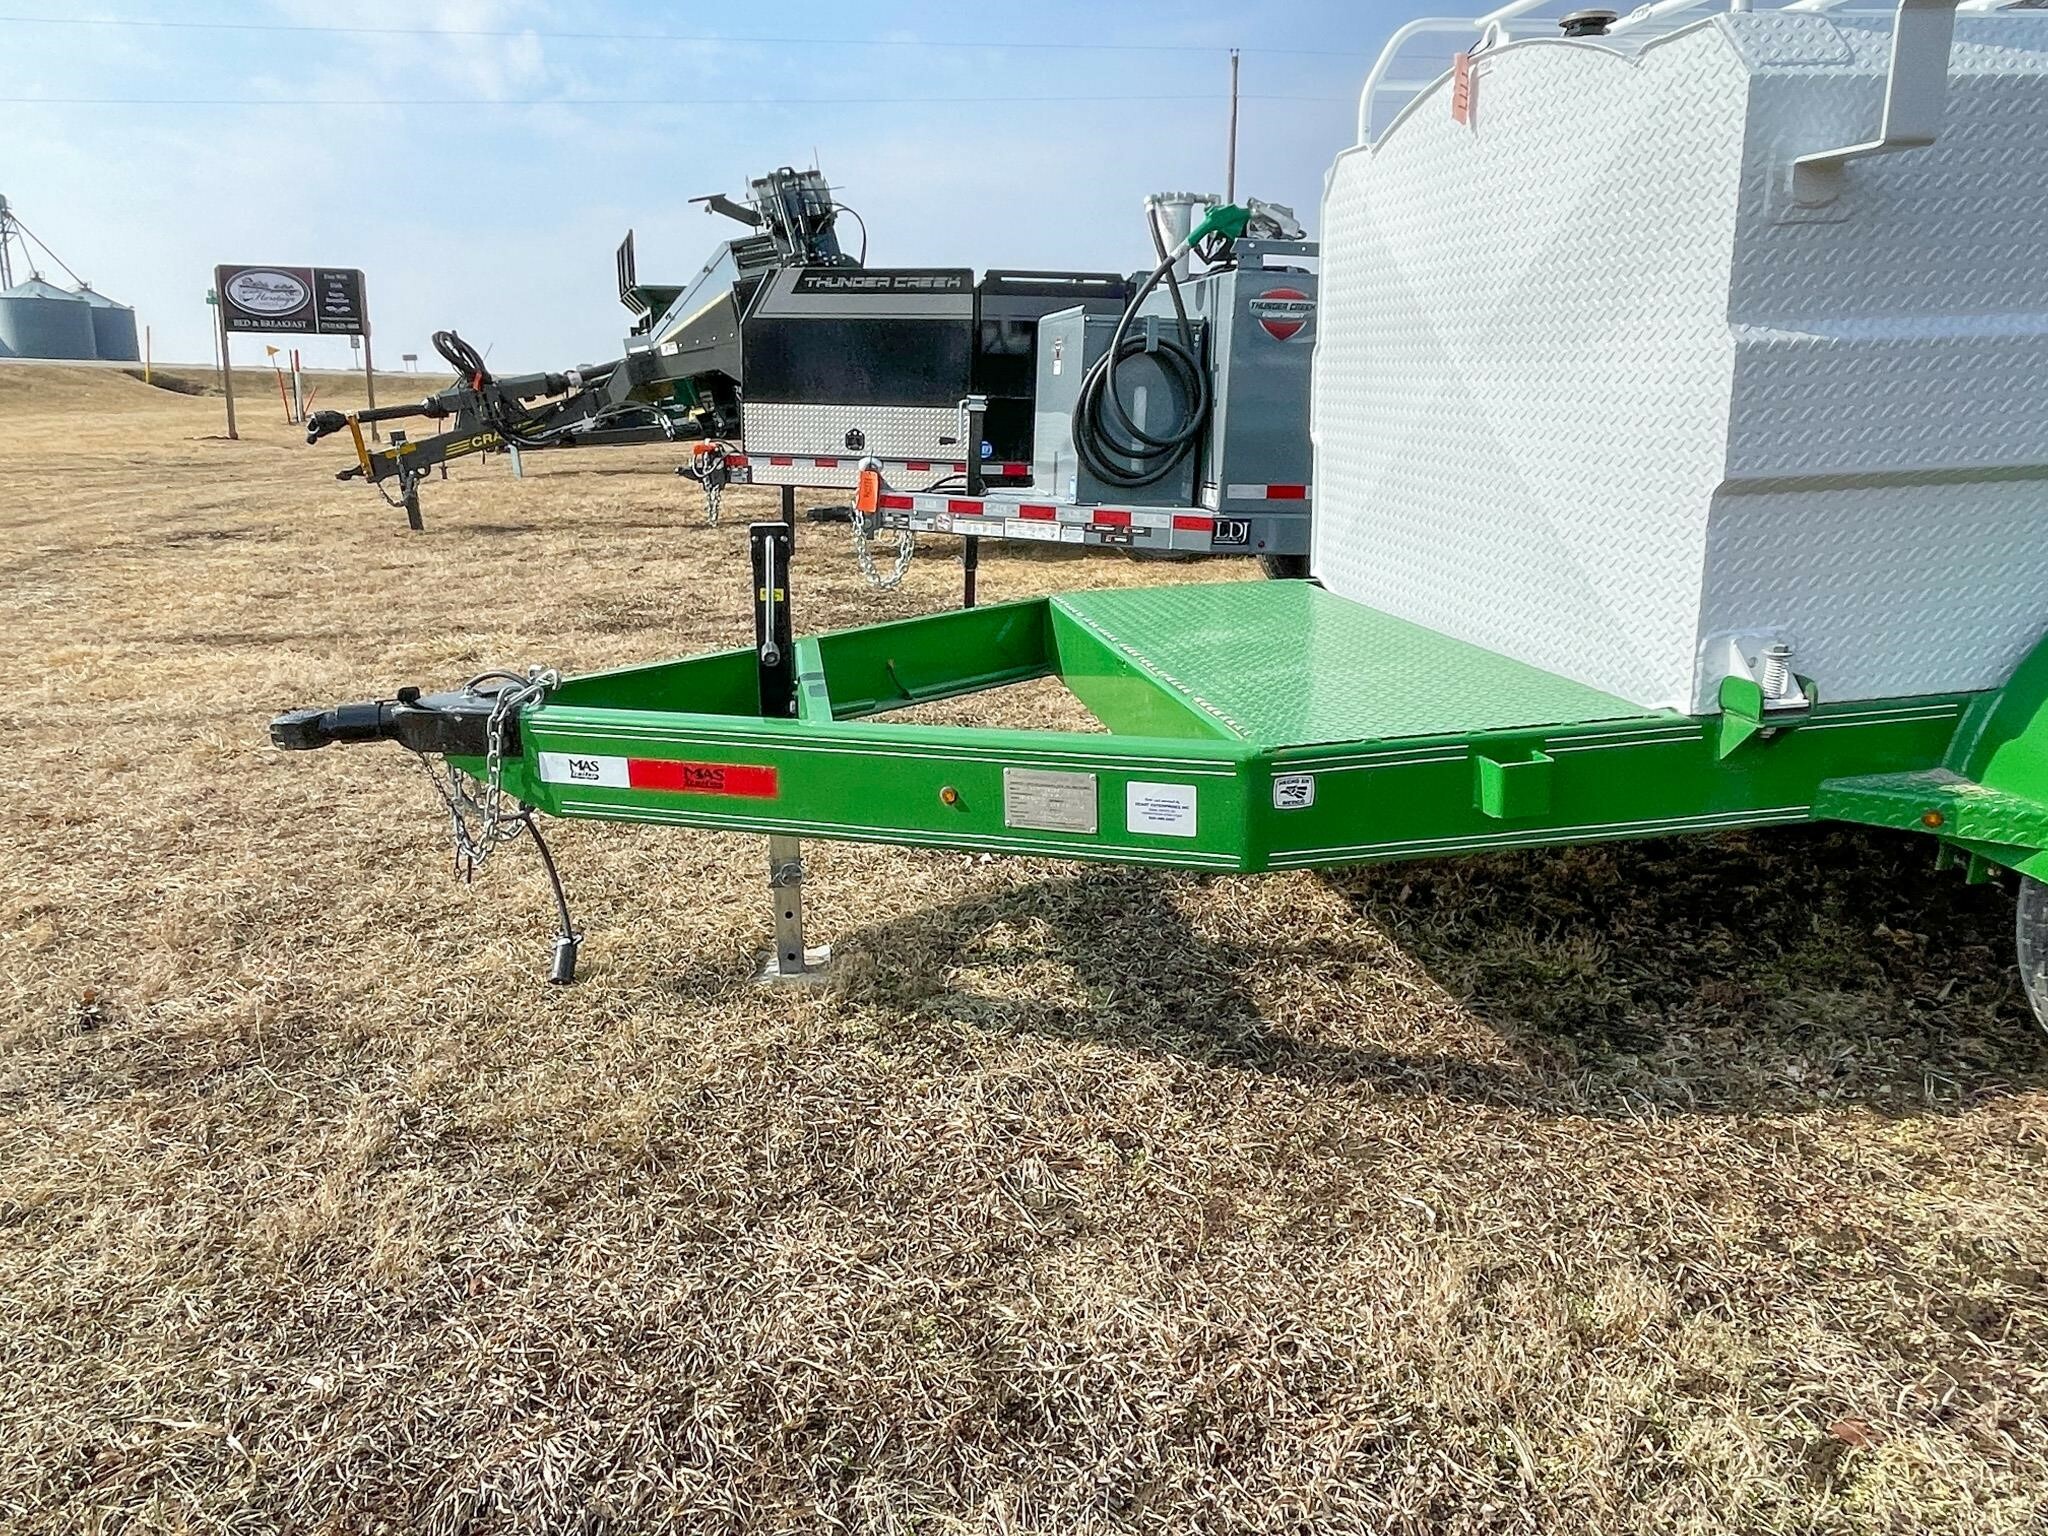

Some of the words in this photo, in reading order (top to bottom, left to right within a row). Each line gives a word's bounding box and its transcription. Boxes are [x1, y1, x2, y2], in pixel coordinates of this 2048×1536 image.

[804, 276, 890, 288] THUNDER
[894, 276, 961, 288] CREEK
[1251, 301, 1289, 311] THUNDER
[1289, 303, 1316, 311] CREEK
[233, 319, 251, 327] BED
[260, 319, 307, 329] BREAKFAST
[1215, 521, 1249, 544] LDJ
[568, 758, 599, 772] MAS
[683, 767, 724, 781] MAS
